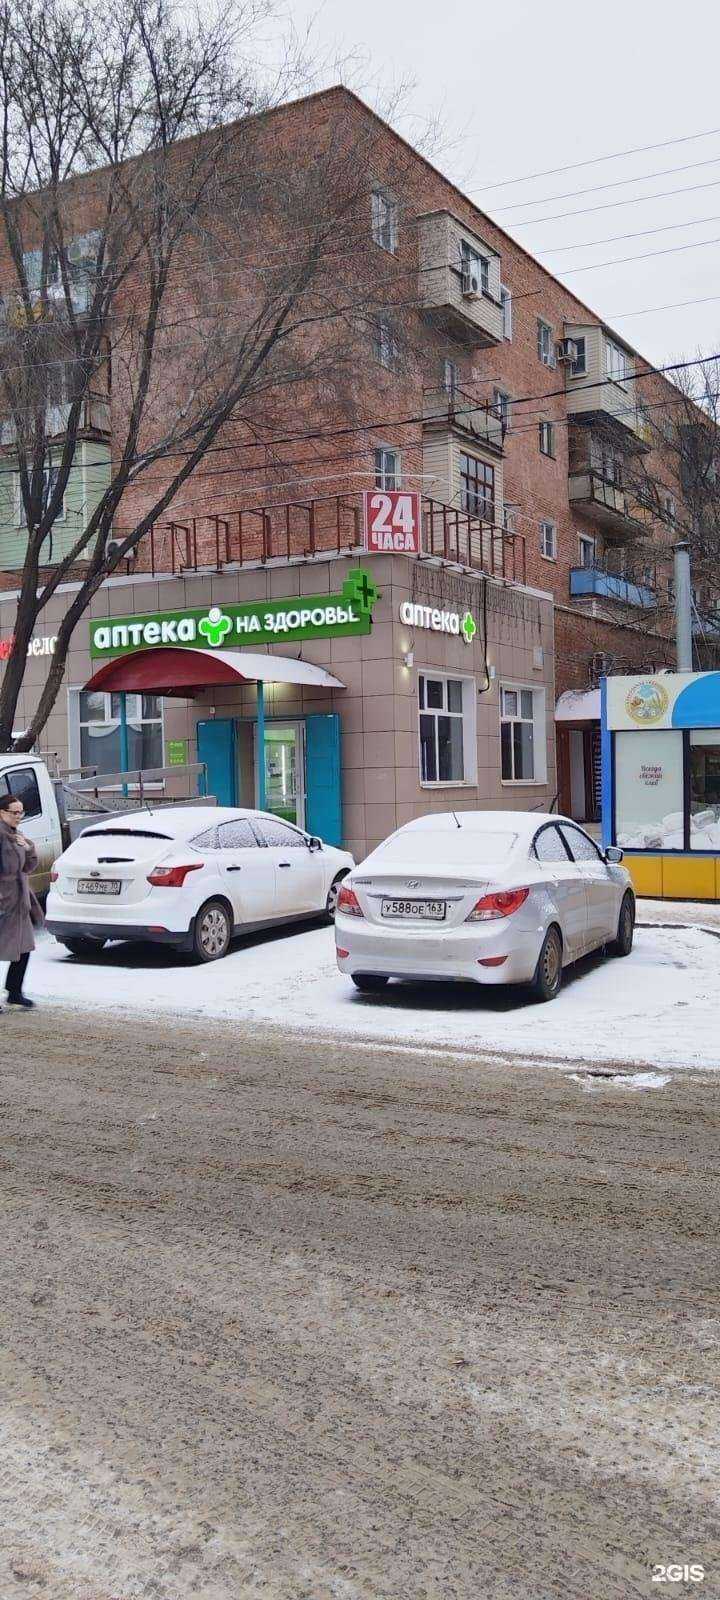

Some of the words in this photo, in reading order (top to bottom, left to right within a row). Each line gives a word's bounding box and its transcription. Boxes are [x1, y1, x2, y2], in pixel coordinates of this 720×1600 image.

[370, 494, 415, 533] 24
[371, 532, 416, 551] ЧАСА
[94, 618, 196, 650] аптека
[236, 615, 264, 635] НА
[400, 601, 460, 635] аптека
[426, 902, 442, 913] 163
